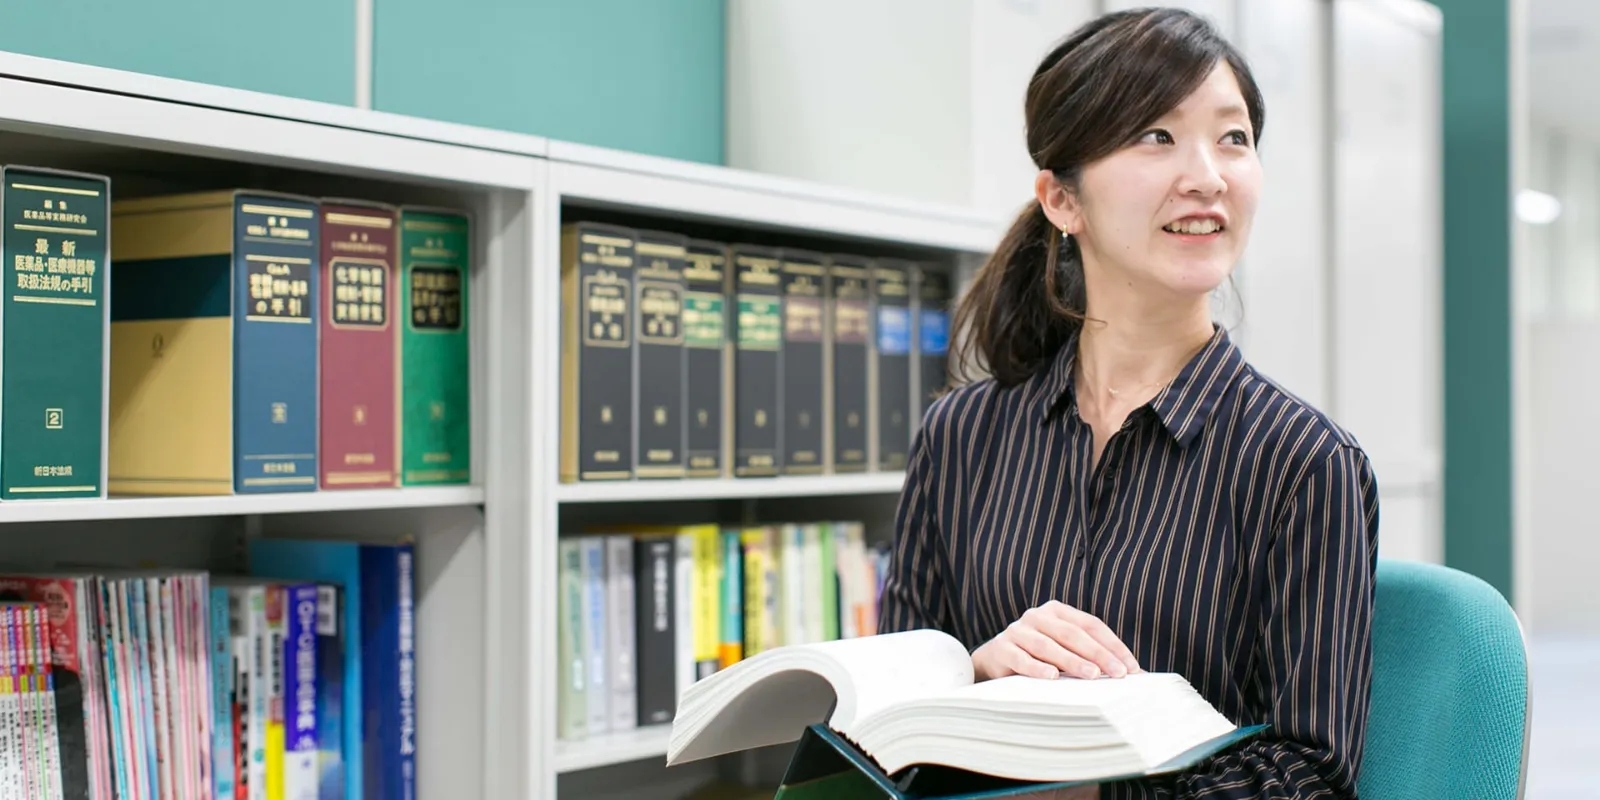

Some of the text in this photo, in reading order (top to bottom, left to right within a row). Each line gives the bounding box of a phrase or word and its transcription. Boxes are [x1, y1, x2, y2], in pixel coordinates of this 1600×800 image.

[36, 238, 76, 256] 最新
[17, 273, 92, 293] 取扱法規の手引
[49, 412, 59, 425] 2
[34, 465, 73, 477] 新日本法規
